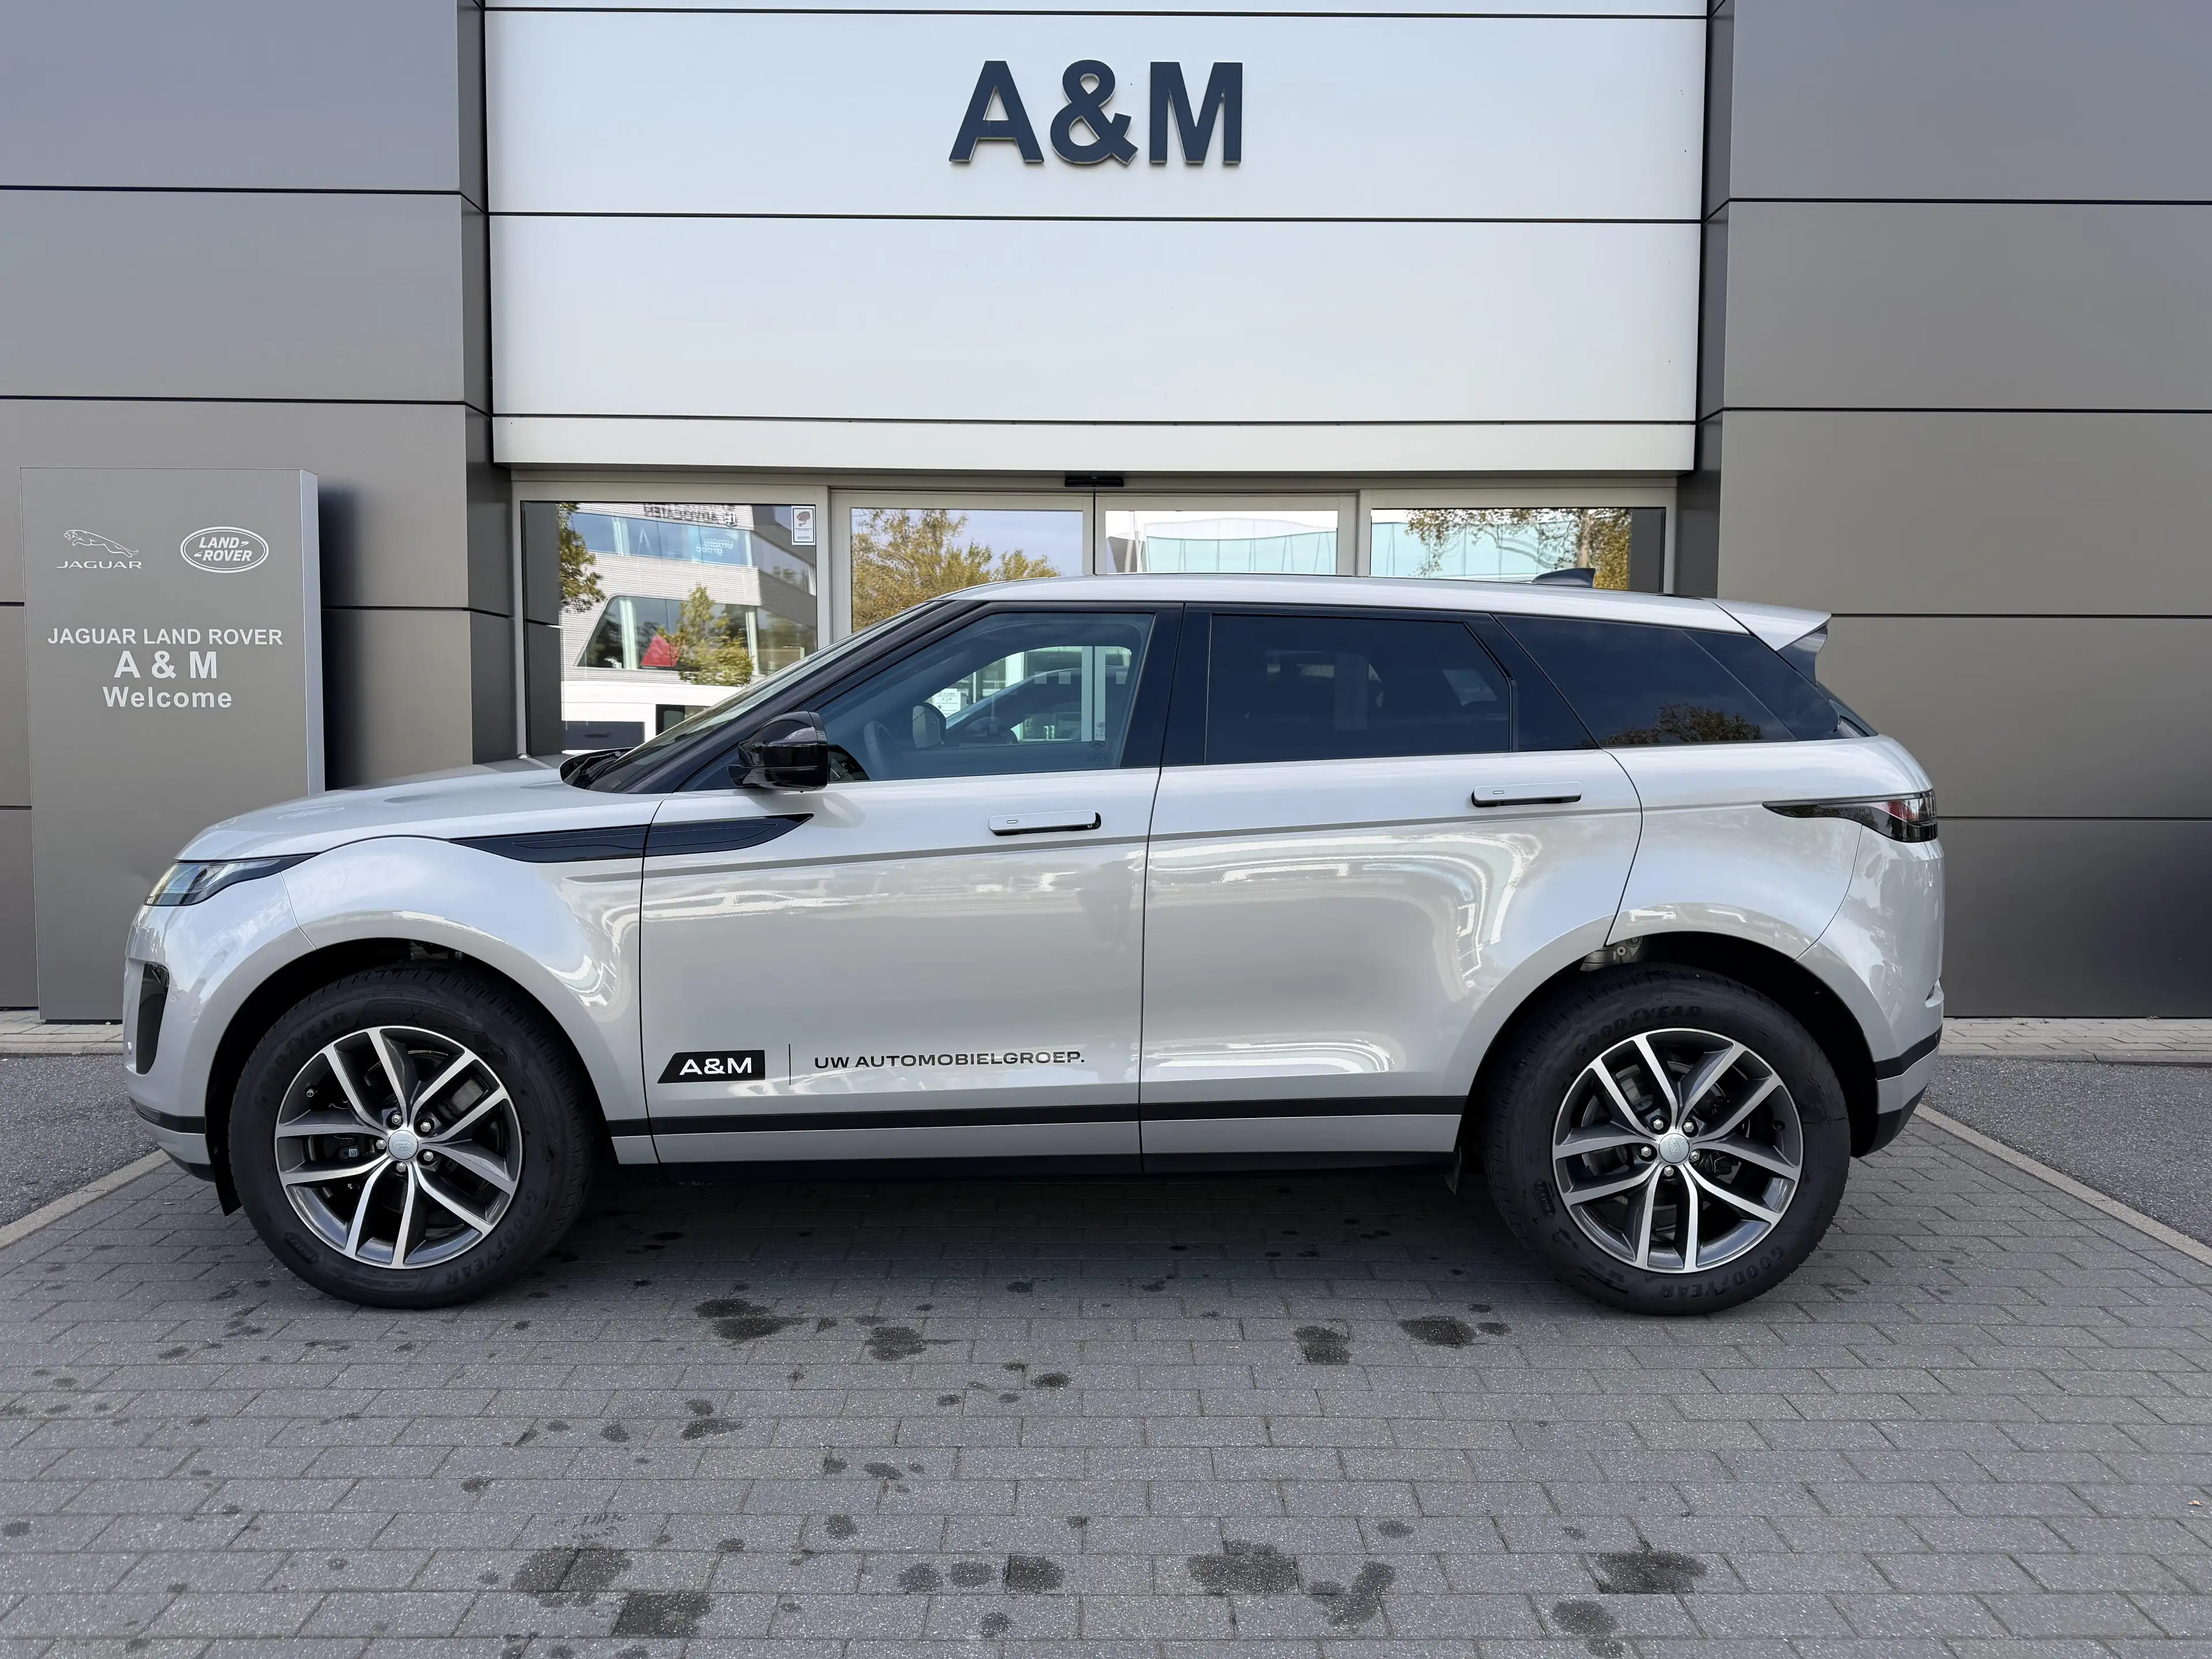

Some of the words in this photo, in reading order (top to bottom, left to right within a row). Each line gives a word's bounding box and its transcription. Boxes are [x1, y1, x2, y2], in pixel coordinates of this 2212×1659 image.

[949, 59, 1243, 165] A&M
[199, 537, 240, 548] LAND
[56, 560, 142, 569] JAGUAR
[202, 550, 252, 562] ROVER
[48, 628, 136, 645] JAGUAR
[143, 628, 200, 645] LAND
[209, 629, 283, 645] ROVER
[114, 651, 141, 678] A
[151, 650, 176, 679] &
[190, 652, 217, 679] M
[103, 686, 232, 708] Welcome
[1574, 1005, 1702, 1056] GOODYEAR
[679, 1057, 752, 1075] A&M
[815, 1056, 849, 1069] UW
[855, 1051, 1085, 1068] AUTOMOBIELGROEP.
[445, 1190, 539, 1286] GOODYEAR
[1659, 1244, 1785, 1298] GOODYEAR
